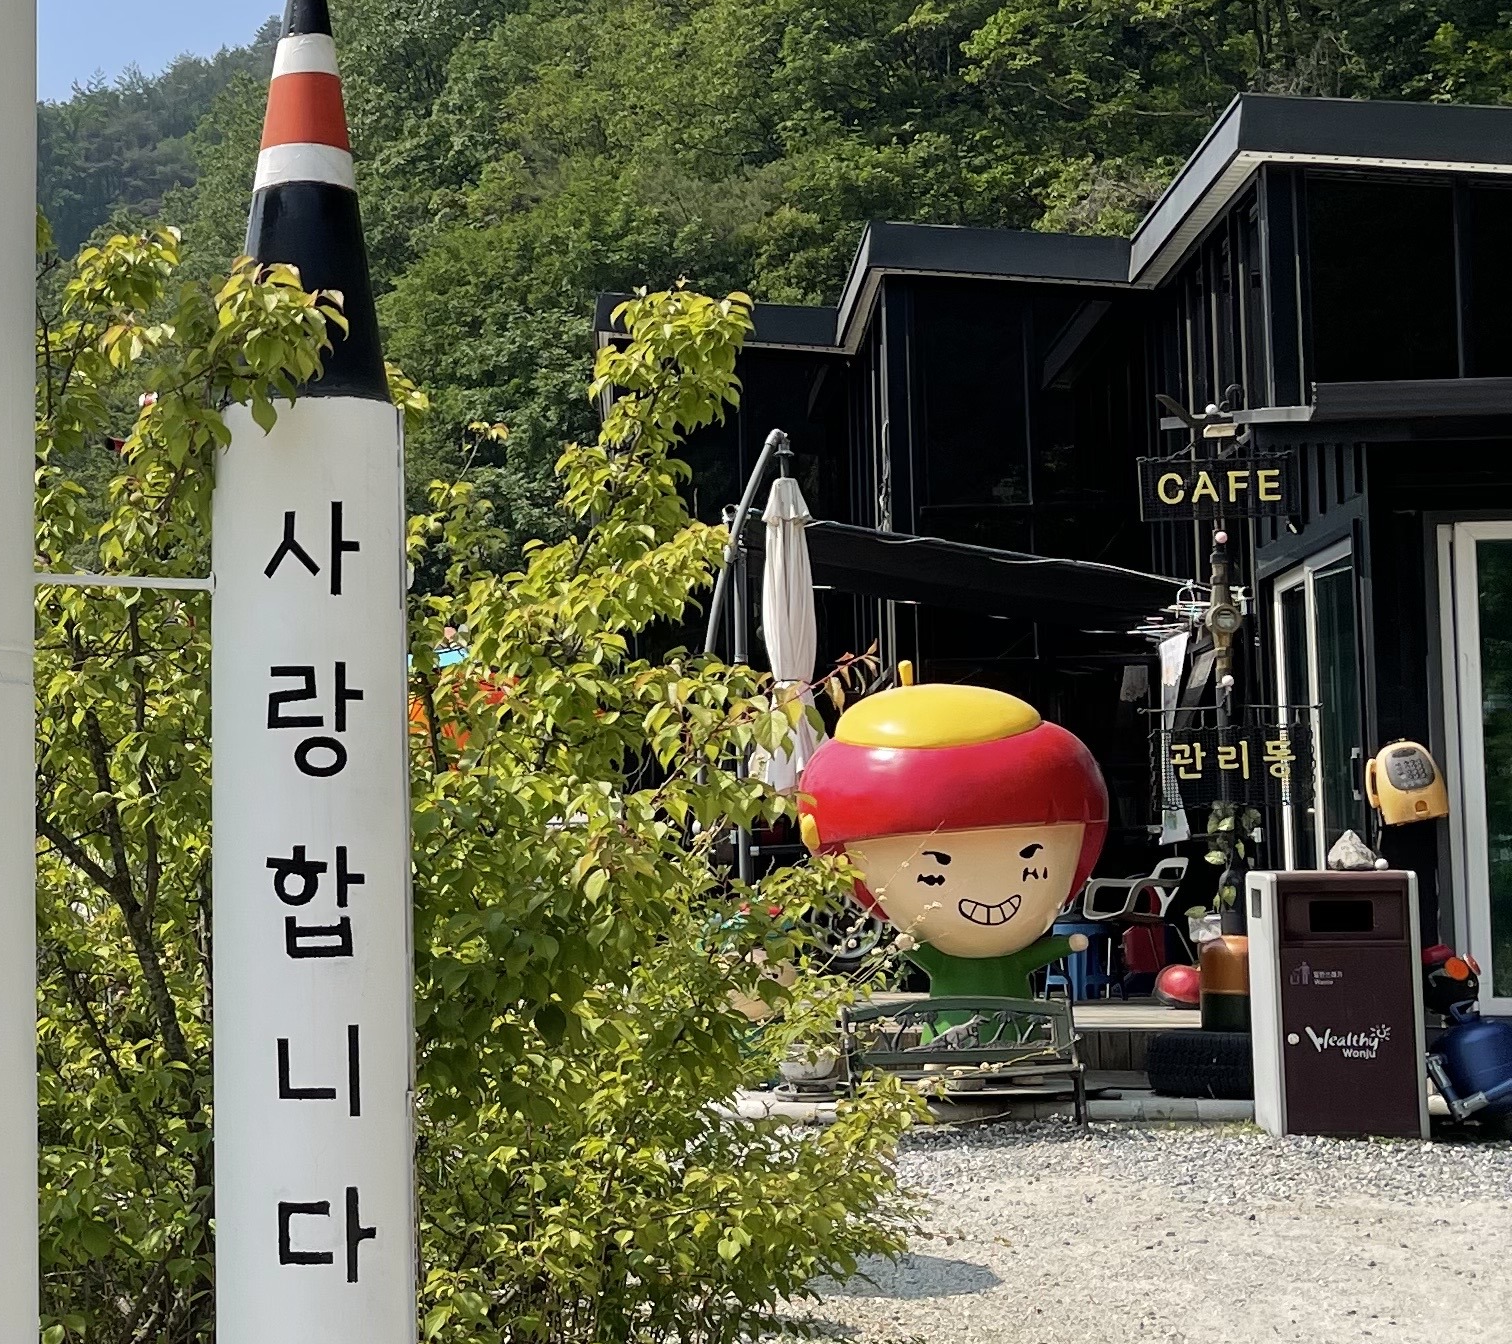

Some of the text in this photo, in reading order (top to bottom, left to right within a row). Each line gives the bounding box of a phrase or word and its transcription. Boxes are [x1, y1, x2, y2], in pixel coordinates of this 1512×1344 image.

[1157, 469, 1282, 505] CAFE
[1170, 740, 1297, 780] 관리동
[263, 500, 377, 1284] 사랑합니다
[1341, 1048, 1376, 1060] Wonju
